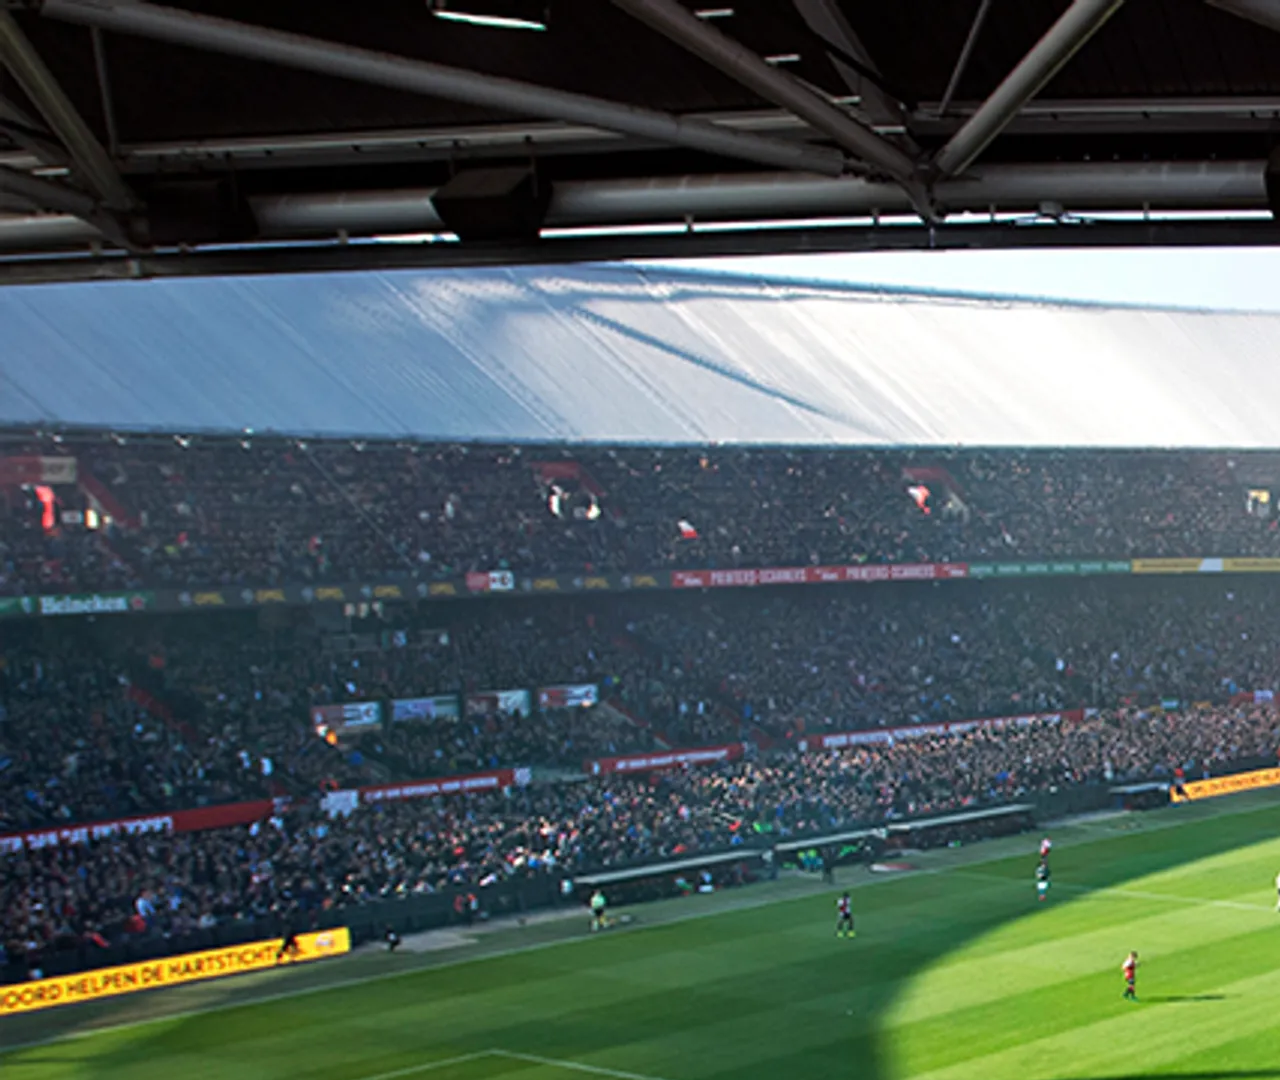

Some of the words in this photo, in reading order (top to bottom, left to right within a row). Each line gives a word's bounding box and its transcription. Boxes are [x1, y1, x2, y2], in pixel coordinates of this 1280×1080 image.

[0, 982, 63, 1010] OORD
[67, 968, 138, 995] HELPEN
[142, 963, 162, 984] DE
